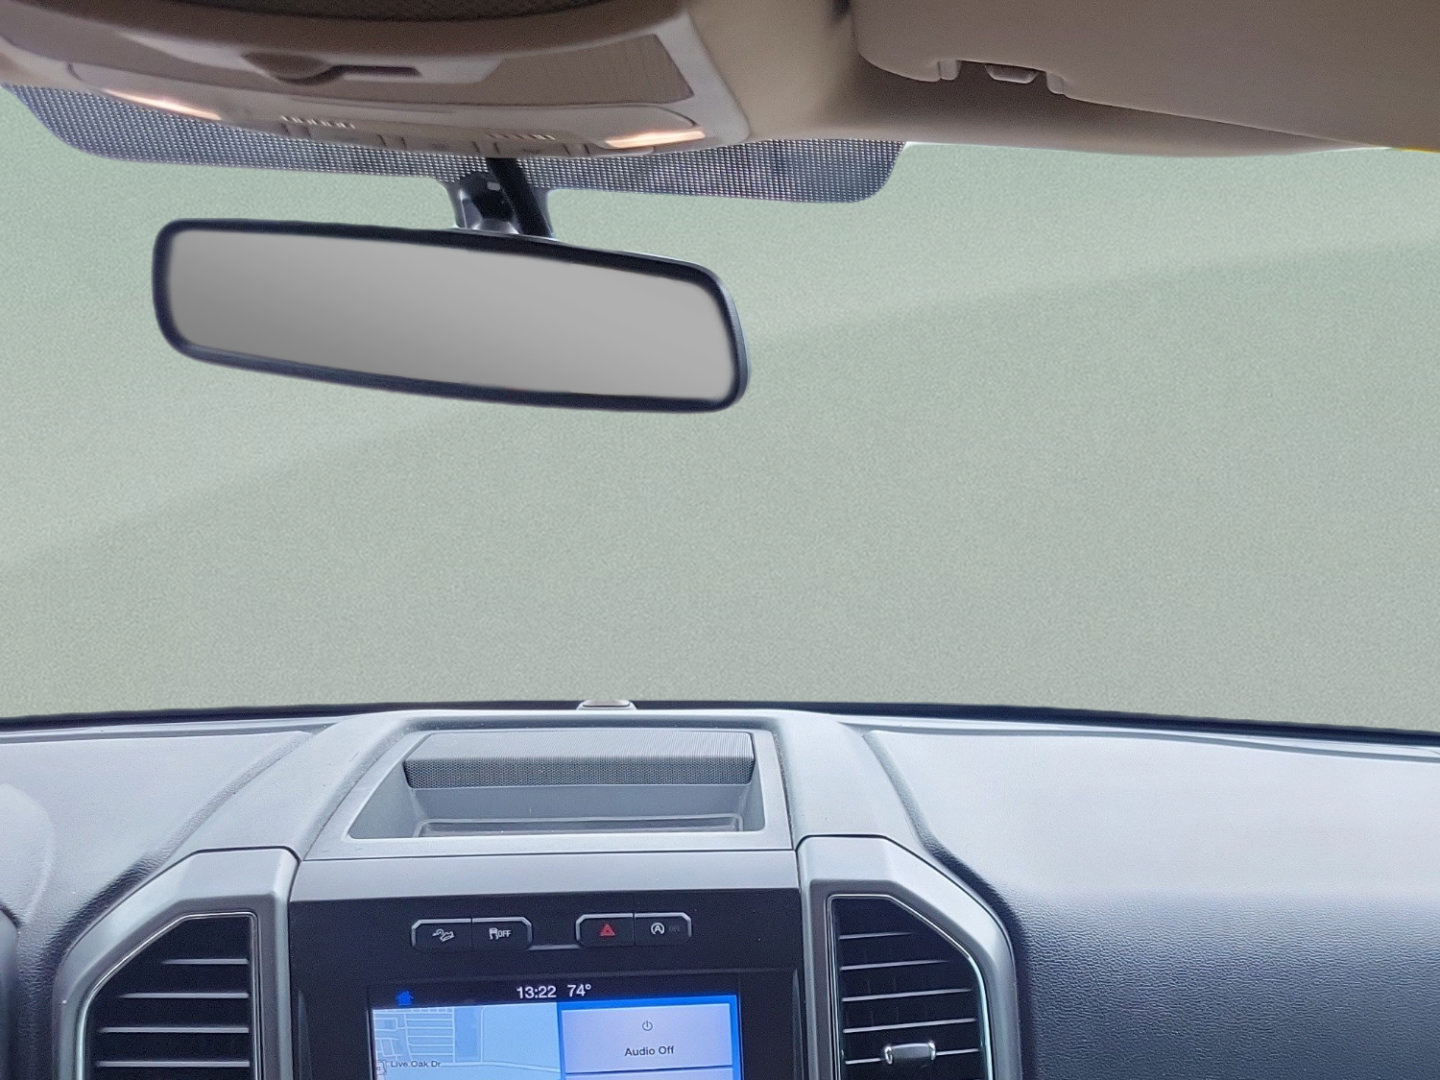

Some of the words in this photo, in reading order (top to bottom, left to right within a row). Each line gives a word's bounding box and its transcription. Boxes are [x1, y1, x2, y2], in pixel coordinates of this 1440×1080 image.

[497, 928, 512, 938] OFF
[516, 986, 557, 998] 13:22
[567, 983, 592, 998] 74°
[624, 1046, 656, 1056] Audio
[658, 1044, 675, 1055] Off
[390, 1060, 408, 1068] Live
[411, 1060, 428, 1068] Oak
[431, 1060, 441, 1068] Dr
